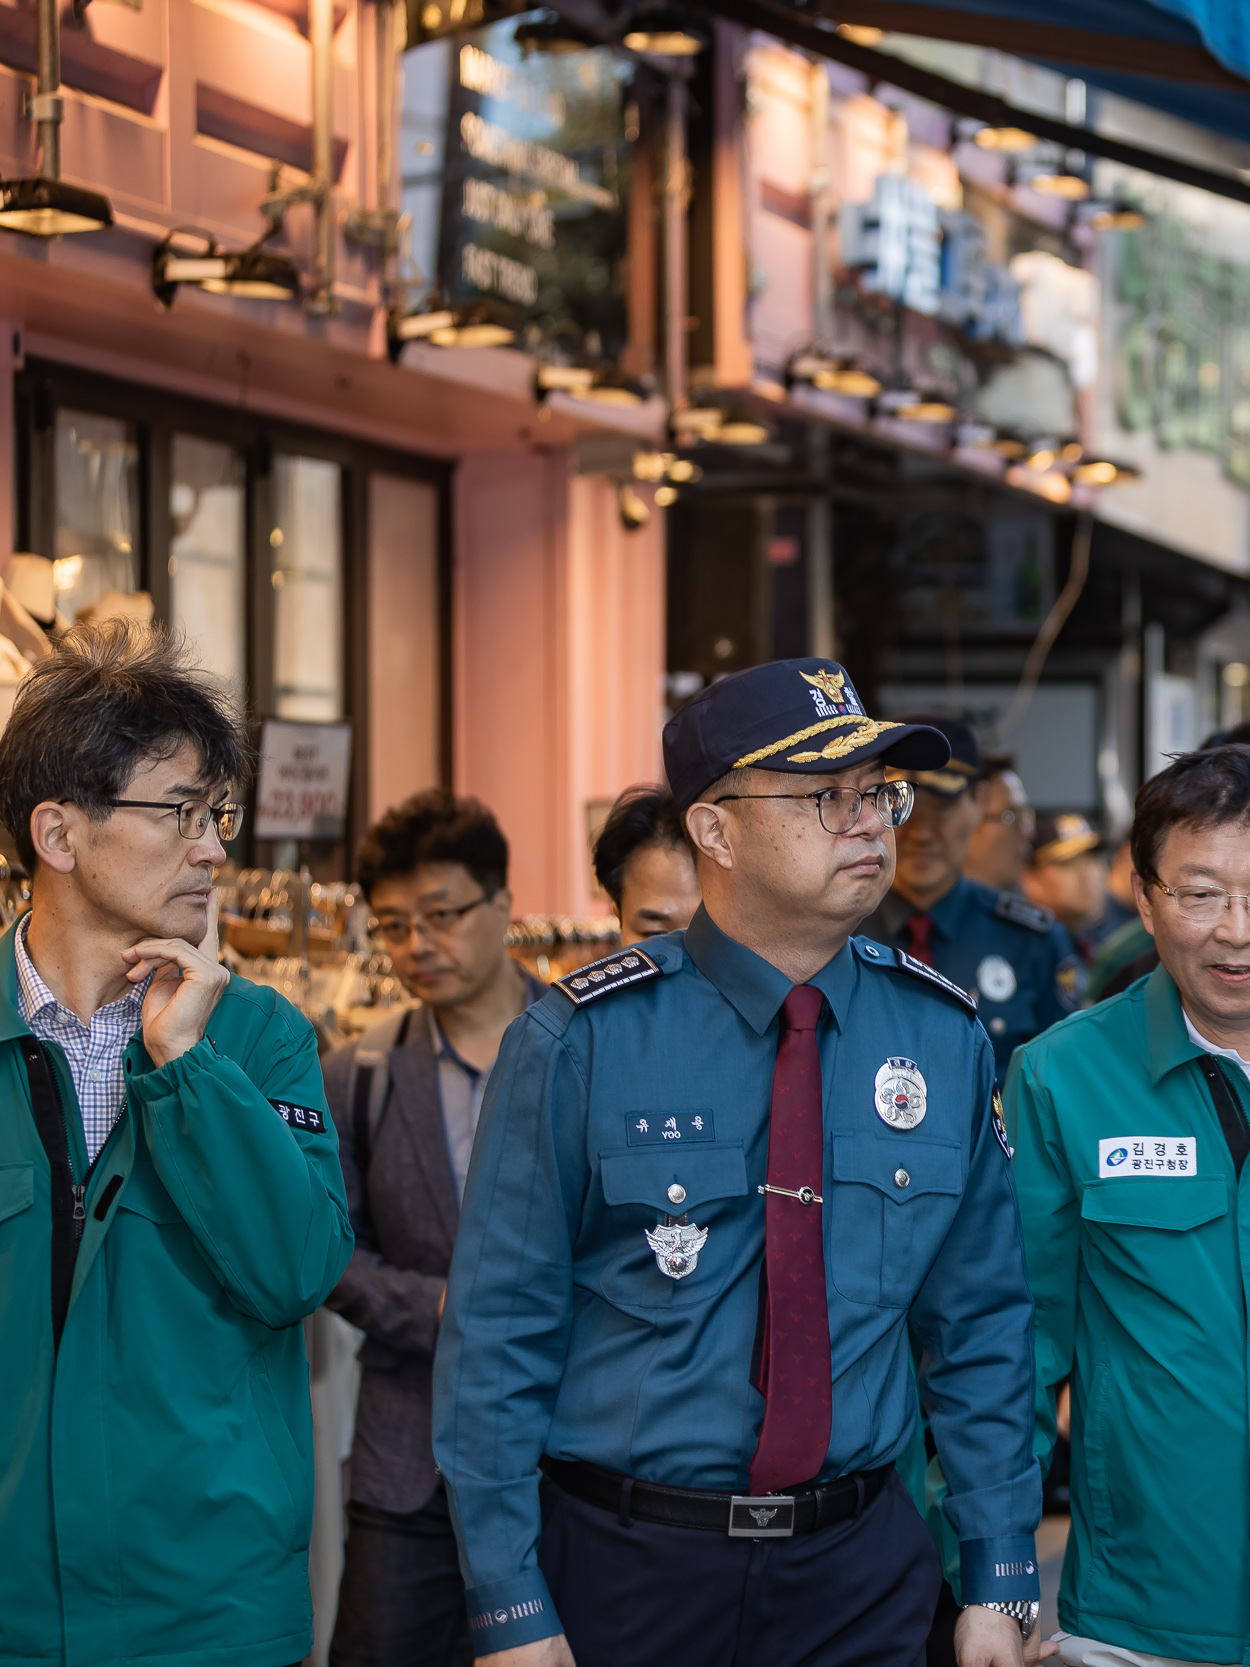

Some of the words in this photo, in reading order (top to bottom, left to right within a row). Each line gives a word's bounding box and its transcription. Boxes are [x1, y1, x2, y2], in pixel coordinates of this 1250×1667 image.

[278, 1104, 320, 1127] 광진구
[661, 1130, 682, 1140] YOO
[1131, 1159, 1189, 1171] 광진구청장
